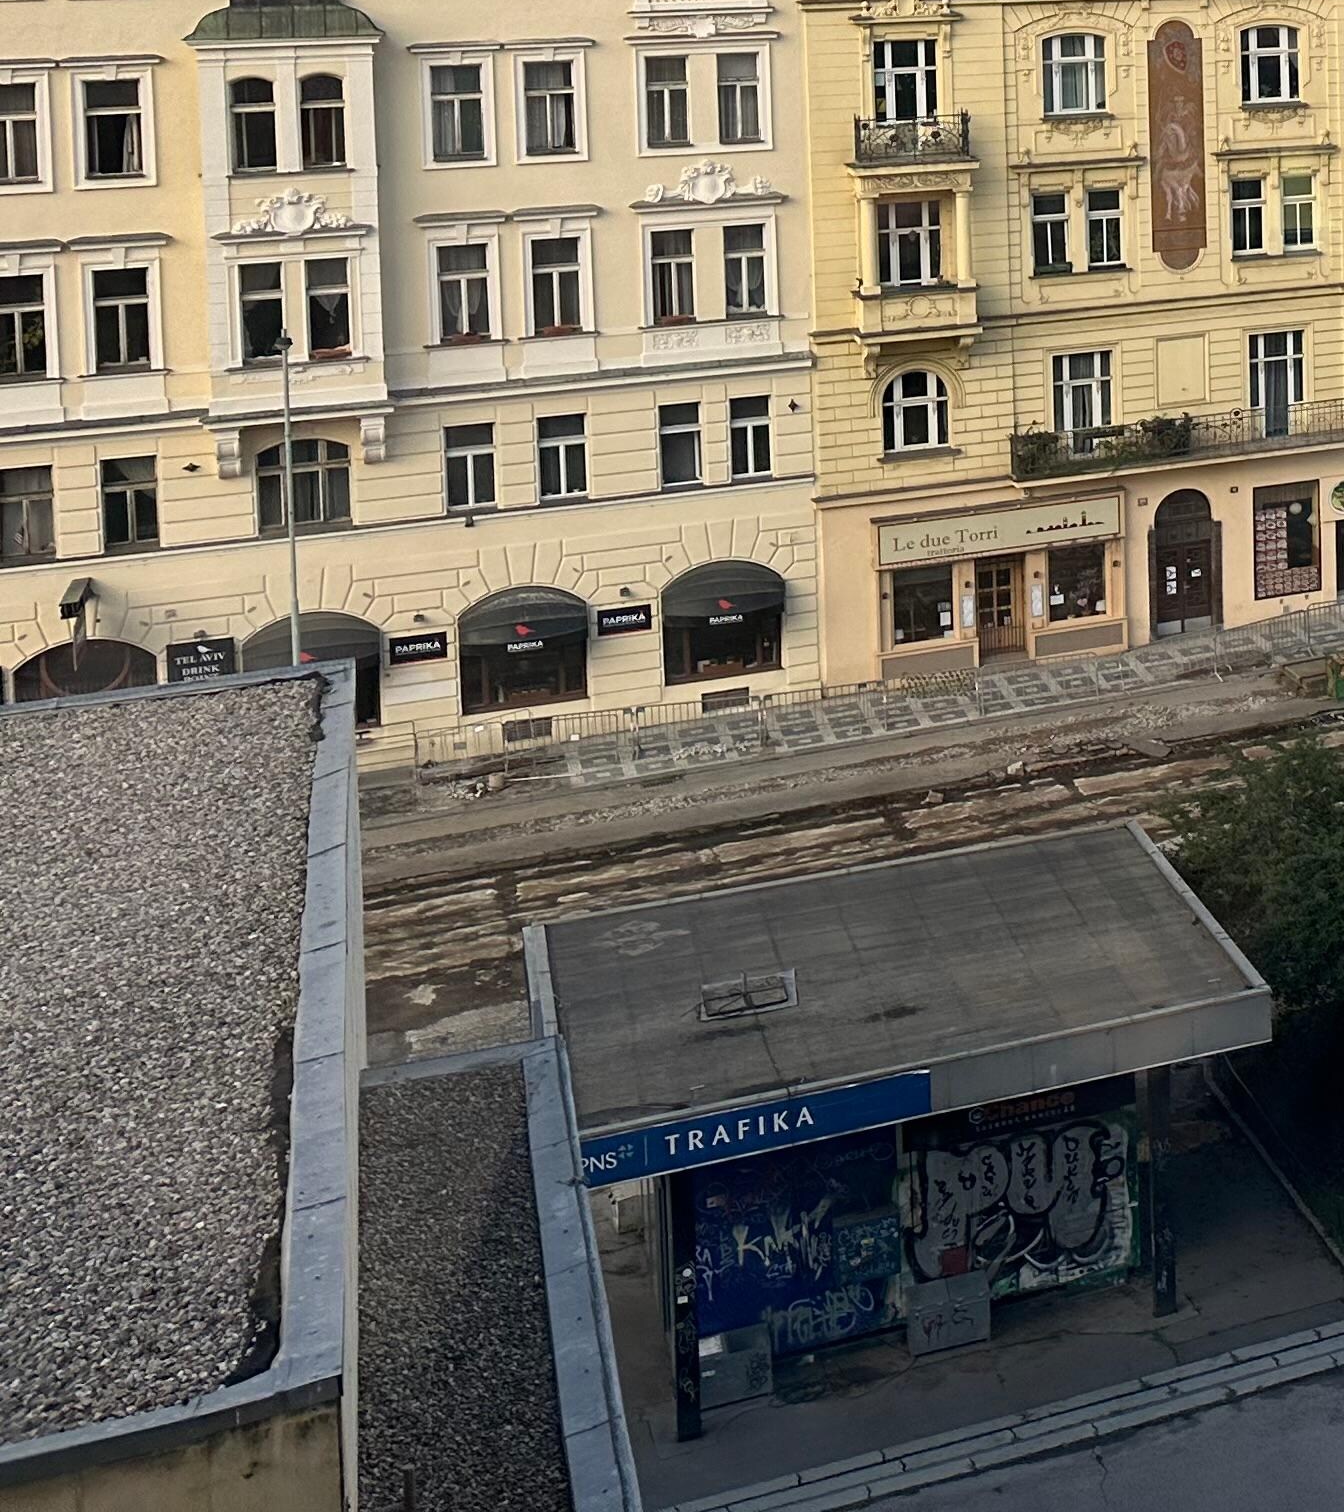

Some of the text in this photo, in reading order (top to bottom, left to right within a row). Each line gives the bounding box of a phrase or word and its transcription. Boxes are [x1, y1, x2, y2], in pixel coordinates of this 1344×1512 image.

[892, 525, 998, 552] Le due Torri
[926, 545, 965, 557] trattoria
[602, 611, 646, 626] PAPRIKA
[708, 614, 744, 626] PAPRIKA
[394, 640, 441, 655] PAPRIKA
[507, 640, 544, 652] PAPRIKA
[174, 651, 226, 665] TEL AVIV
[181, 664, 220, 676] DRINK
[665, 1106, 815, 1156] TRAFIKA
